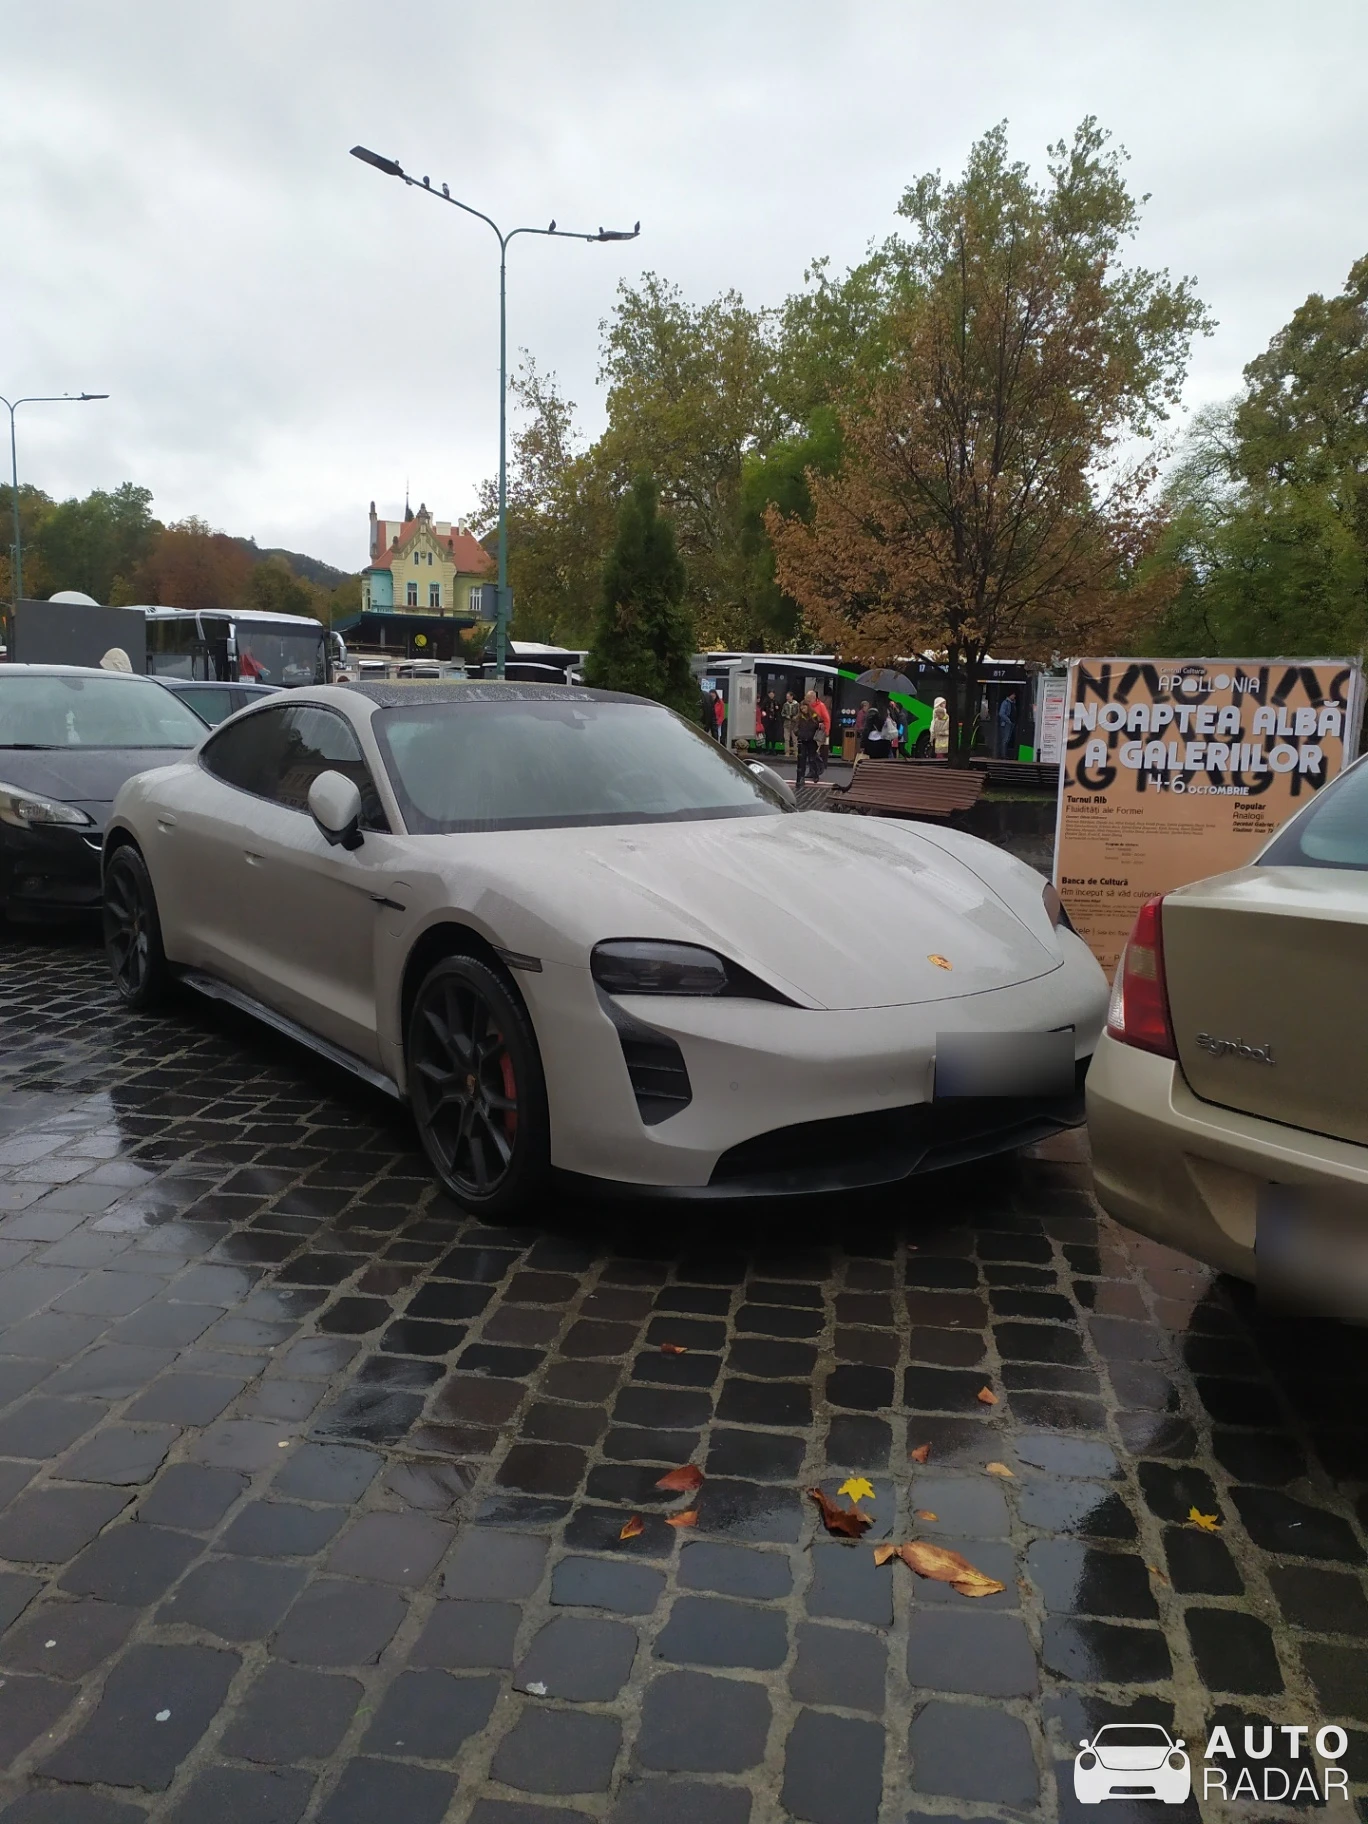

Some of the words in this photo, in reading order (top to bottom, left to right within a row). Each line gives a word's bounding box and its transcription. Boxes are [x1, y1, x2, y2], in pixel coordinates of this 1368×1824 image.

[1158, 674, 1260, 693] APOLLONIA
[1073, 702, 1241, 735] NOAPTEA
[1253, 700, 1342, 737] ALBĂ
[1085, 738, 1108, 768] A
[1119, 740, 1322, 774] GALERIILOR
[1148, 773, 1185, 794] 4-6
[1188, 785, 1250, 796] OCTOMBRIE
[1066, 795, 1092, 803] Turnul
[1094, 796, 1107, 804] Alb
[1102, 806, 1114, 814] ale
[1116, 806, 1144, 815] Formei
[1234, 802, 1266, 811] Popular
[1062, 876, 1085, 885] Banca
[1087, 877, 1098, 885] de
[1100, 877, 1128, 886] Cultură
[1061, 887, 1074, 896] Am
